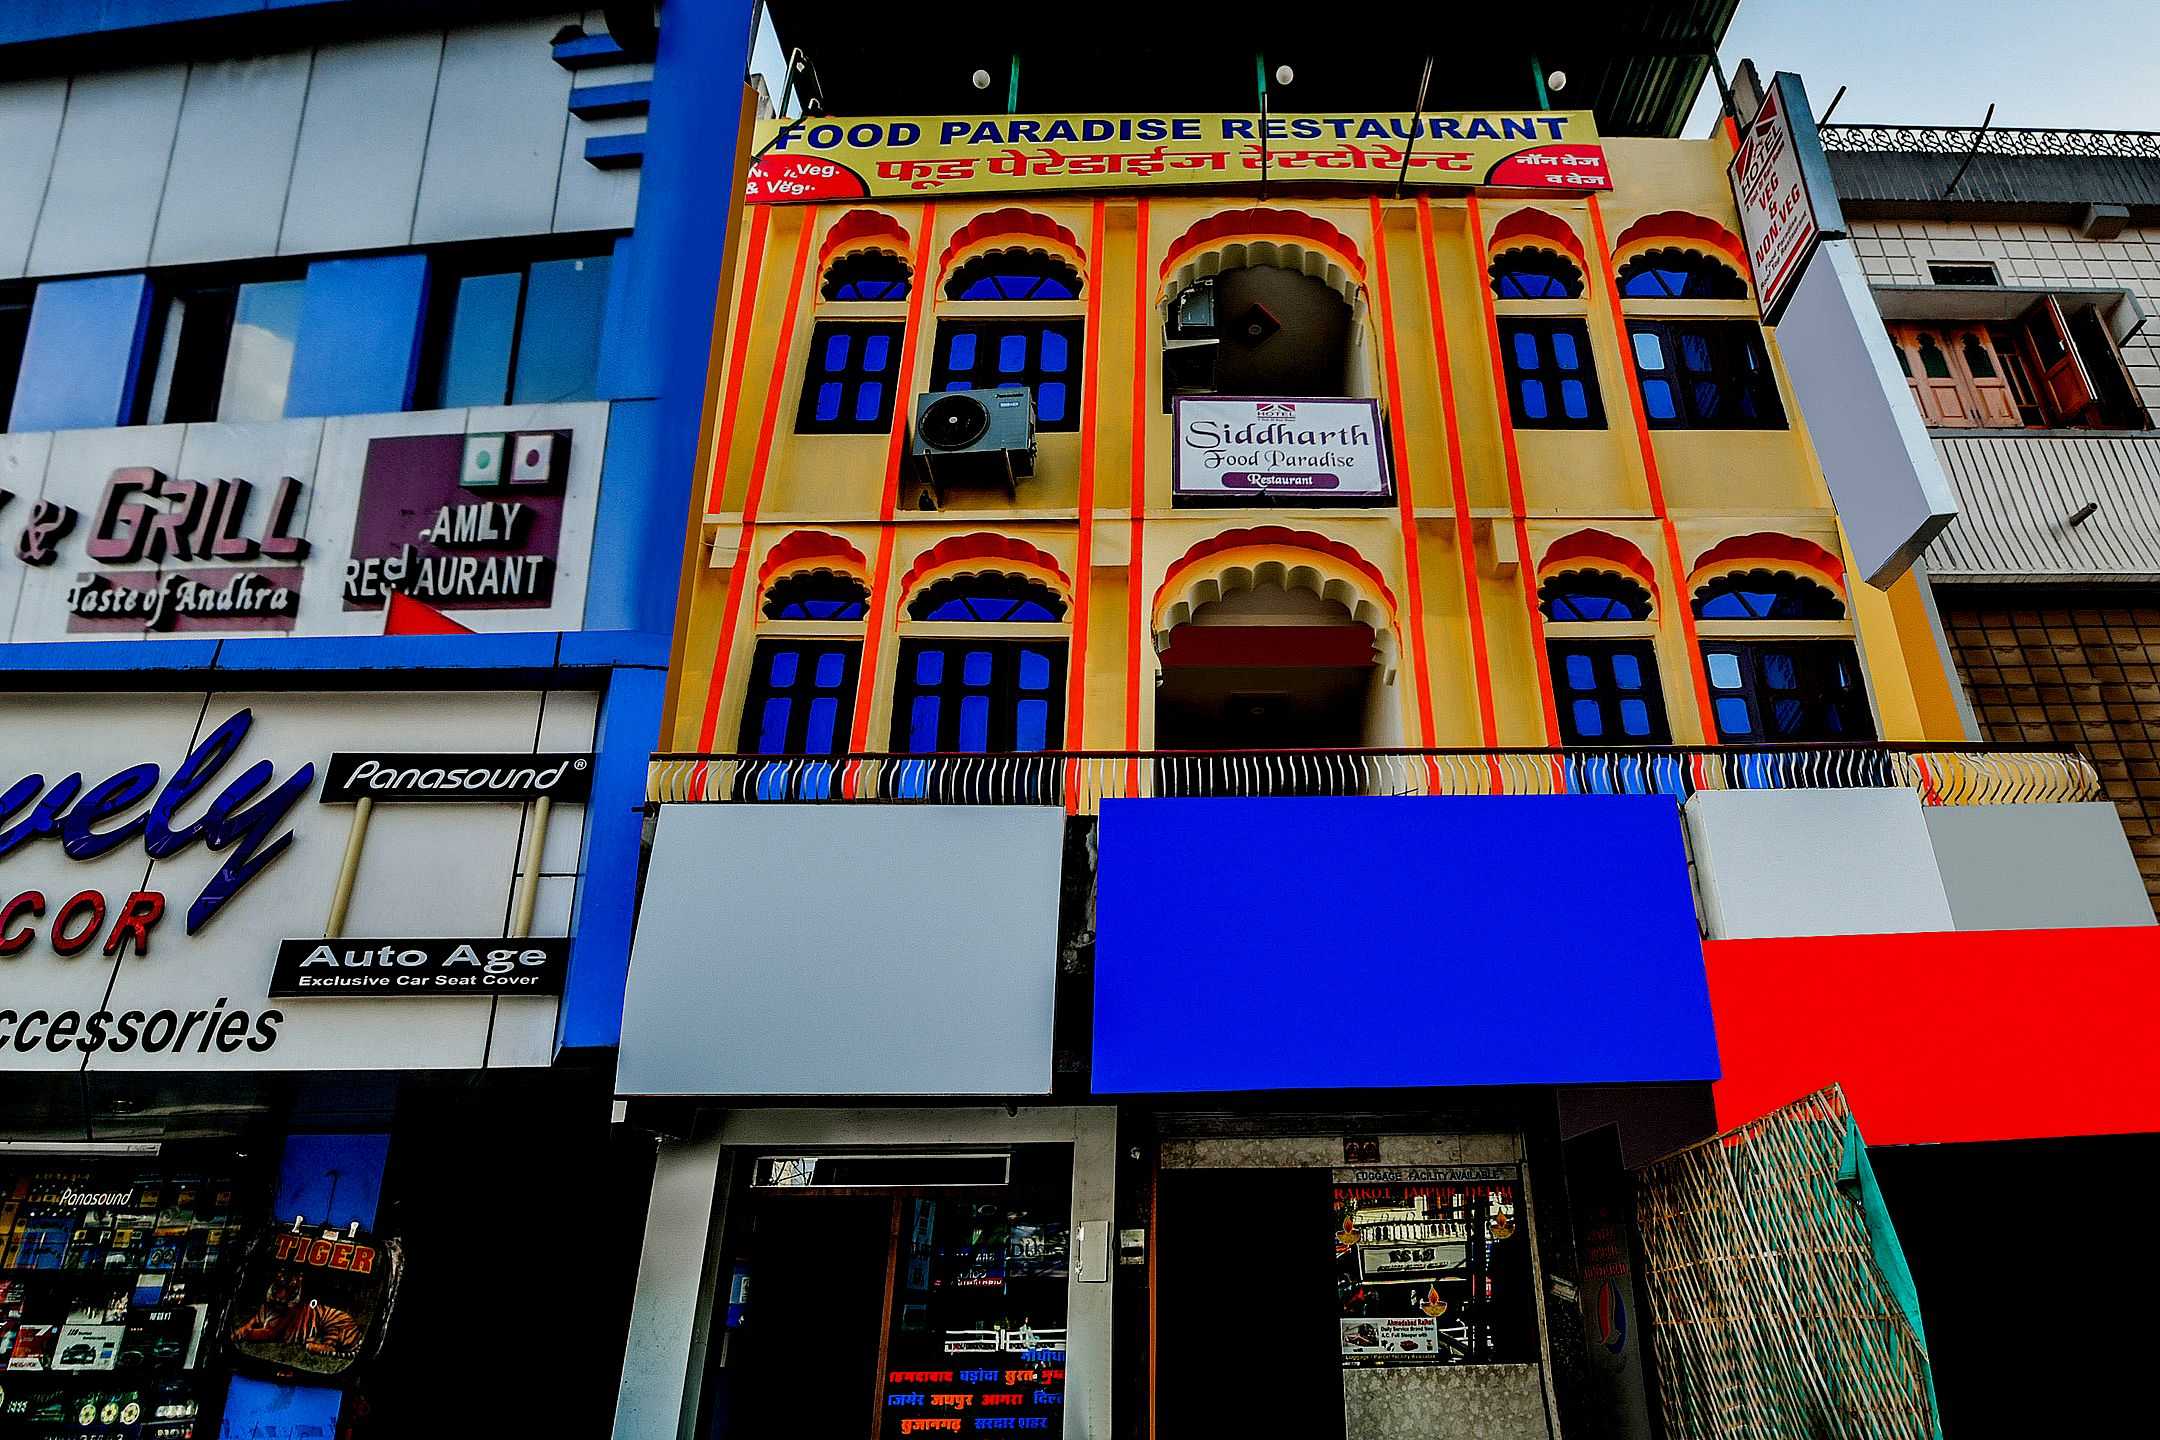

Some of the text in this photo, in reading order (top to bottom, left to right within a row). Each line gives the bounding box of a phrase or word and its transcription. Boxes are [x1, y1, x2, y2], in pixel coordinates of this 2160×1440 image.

[775, 116, 1570, 151] FOOD PARADISE RESTAURANT
[876, 158, 980, 190] फूड
[987, 145, 1230, 177] पेरेडाईज
[1515, 153, 1601, 167] नॉन वेज
[1741, 126, 1783, 198] HOTEL
[1566, 172, 1605, 185] वेज
[1758, 172, 1780, 213] VEG
[1185, 421, 1369, 449] Siddharth
[1204, 449, 1355, 472] Food Paradise
[1247, 473, 1313, 488] Restaurant
[15, 466, 308, 563] & GRILL
[70, 572, 289, 628] Taste of Andhra
[299, 944, 547, 974] Auto Age
[298, 975, 539, 987] Exclusive Car Seat Cover
[1356, 1169, 1501, 1181] LUGGAGE FACILITY AVAILABLE
[59, 1187, 134, 1206] Panasound
[275, 1232, 376, 1275] TIGER
